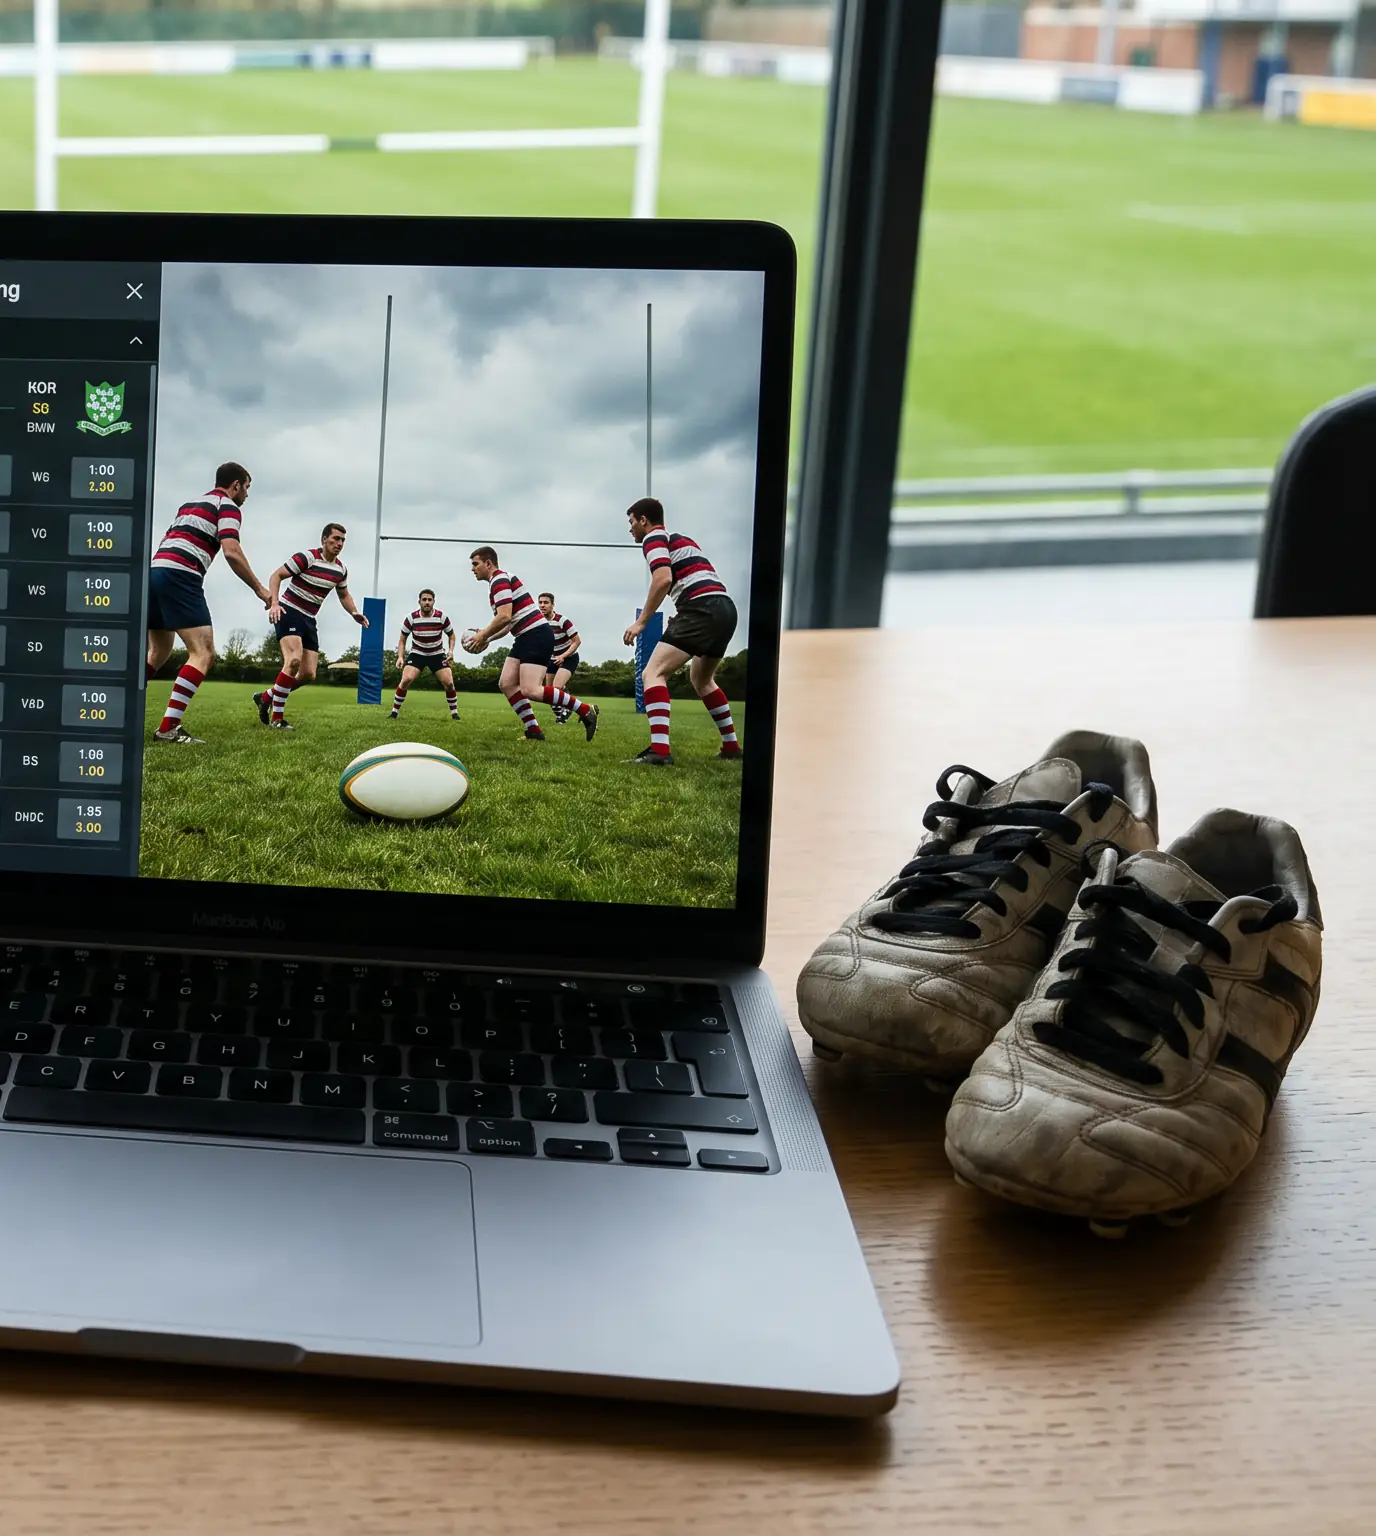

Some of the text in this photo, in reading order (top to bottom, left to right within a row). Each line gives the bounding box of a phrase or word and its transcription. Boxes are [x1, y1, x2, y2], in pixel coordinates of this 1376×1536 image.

[28, 381, 57, 394] KOR
[89, 464, 115, 476] 1:00
[87, 521, 113, 533] 1:00
[86, 538, 113, 550] 1.00
[84, 578, 111, 590] 1:00
[27, 584, 46, 596] WS
[84, 595, 111, 607] 1.00
[83, 635, 109, 647] 1.50
[27, 641, 43, 652] SD
[82, 651, 109, 663] 1.00
[81, 692, 107, 704] 1.00
[79, 708, 107, 720] 2.00
[22, 755, 39, 767] BS
[78, 765, 105, 777] 1.00
[75, 821, 102, 834] 3.00
[48, 979, 59, 987] 4
[179, 986, 192, 995] 6
[8, 1001, 21, 1010] E
[381, 999, 393, 1007] 9
[74, 1005, 87, 1014] R
[142, 1009, 154, 1018] T
[210, 1013, 222, 1022] Y
[277, 1018, 291, 1027] U
[351, 1022, 355, 1031] I
[415, 1026, 429, 1035] O
[14, 1032, 28, 1041] D
[485, 1029, 497, 1038] P
[84, 1036, 95, 1045] F
[152, 1041, 166, 1050] G
[221, 1045, 235, 1055] H
[292, 1050, 304, 1059] J
[363, 1054, 375, 1064] K
[435, 1058, 445, 1068] L
[40, 1066, 54, 1076] C
[112, 1070, 126, 1080] V
[182, 1075, 195, 1085] B
[254, 1080, 268, 1090] N
[324, 1084, 341, 1095] M
[546, 1092, 557, 1102] ?
[384, 1130, 448, 1142] command
